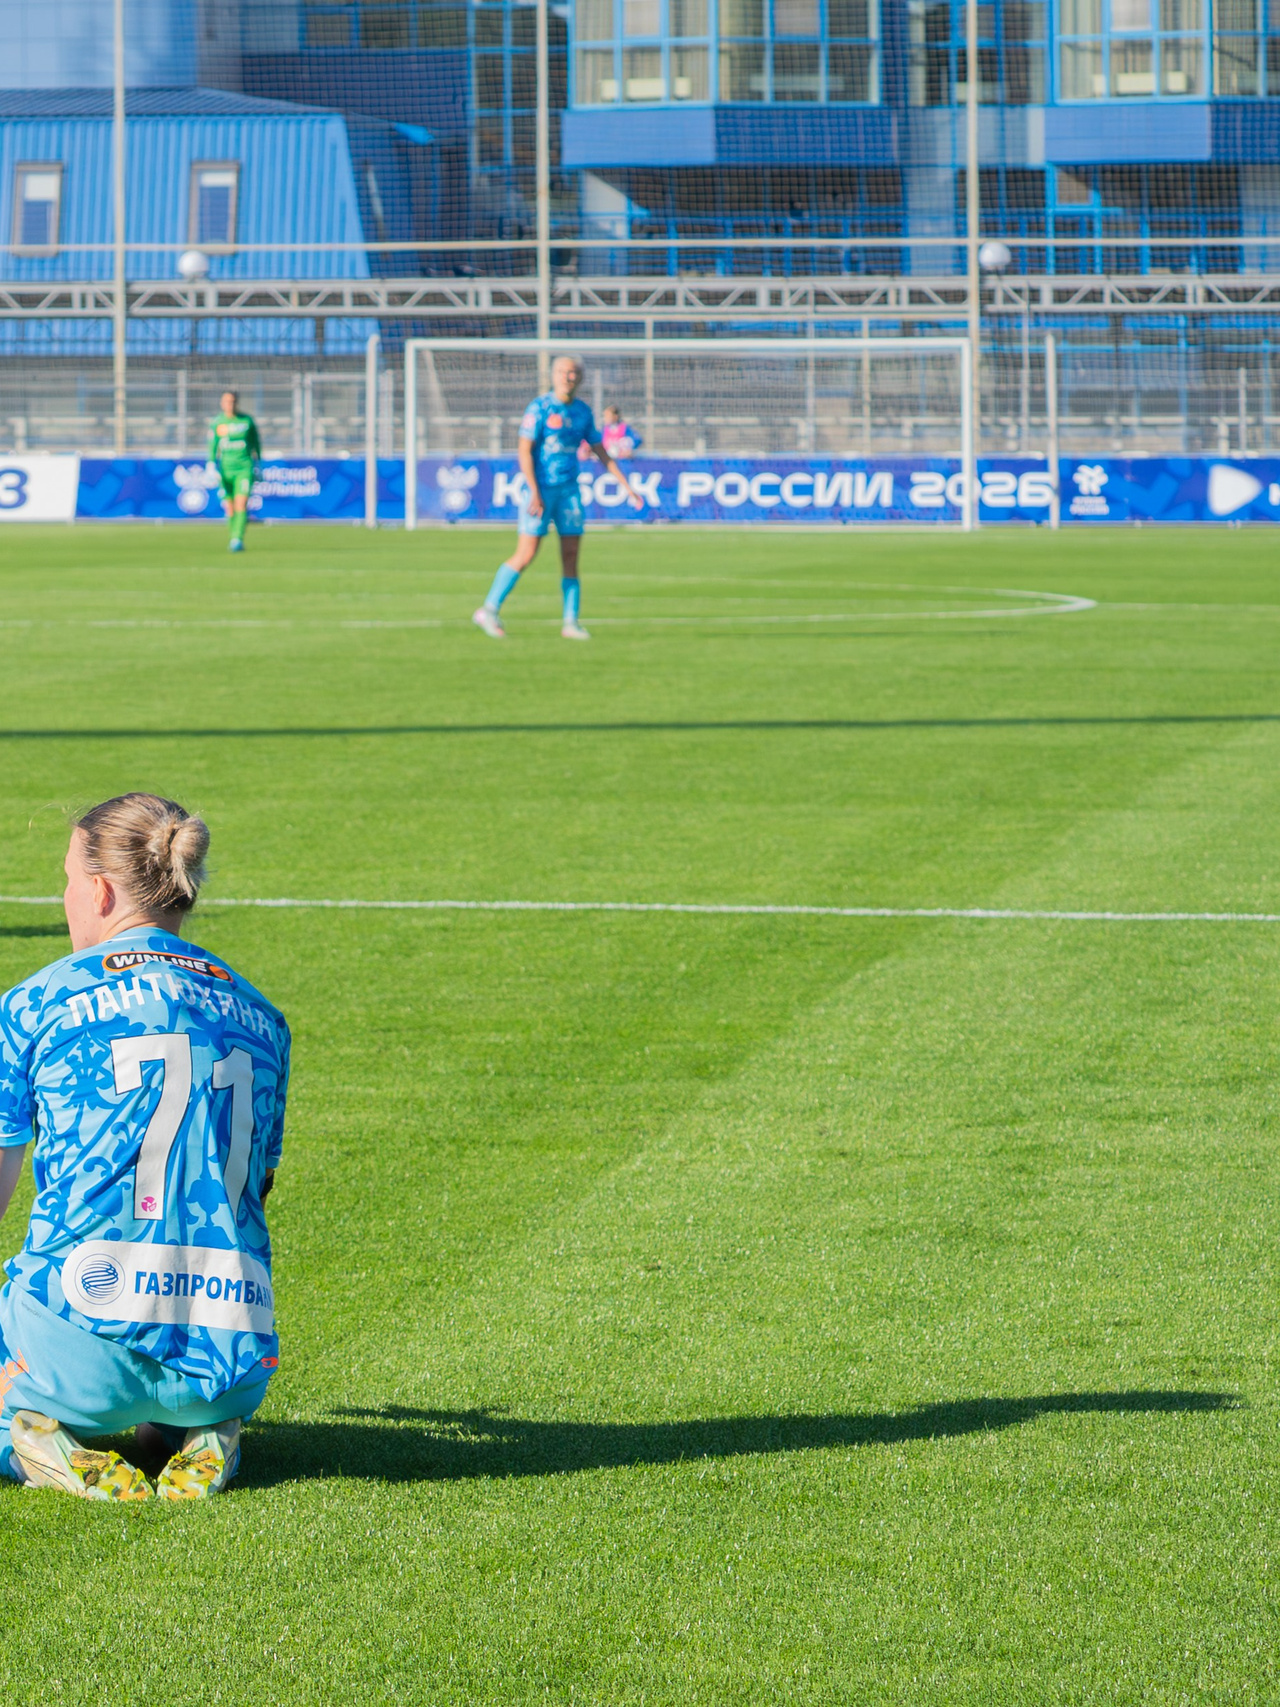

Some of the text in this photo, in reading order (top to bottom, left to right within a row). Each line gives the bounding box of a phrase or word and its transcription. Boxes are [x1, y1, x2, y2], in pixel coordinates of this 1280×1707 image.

[677, 471, 894, 508] РОССИИ
[113, 954, 208, 973] WINLINE
[110, 1032, 256, 1227] 71
